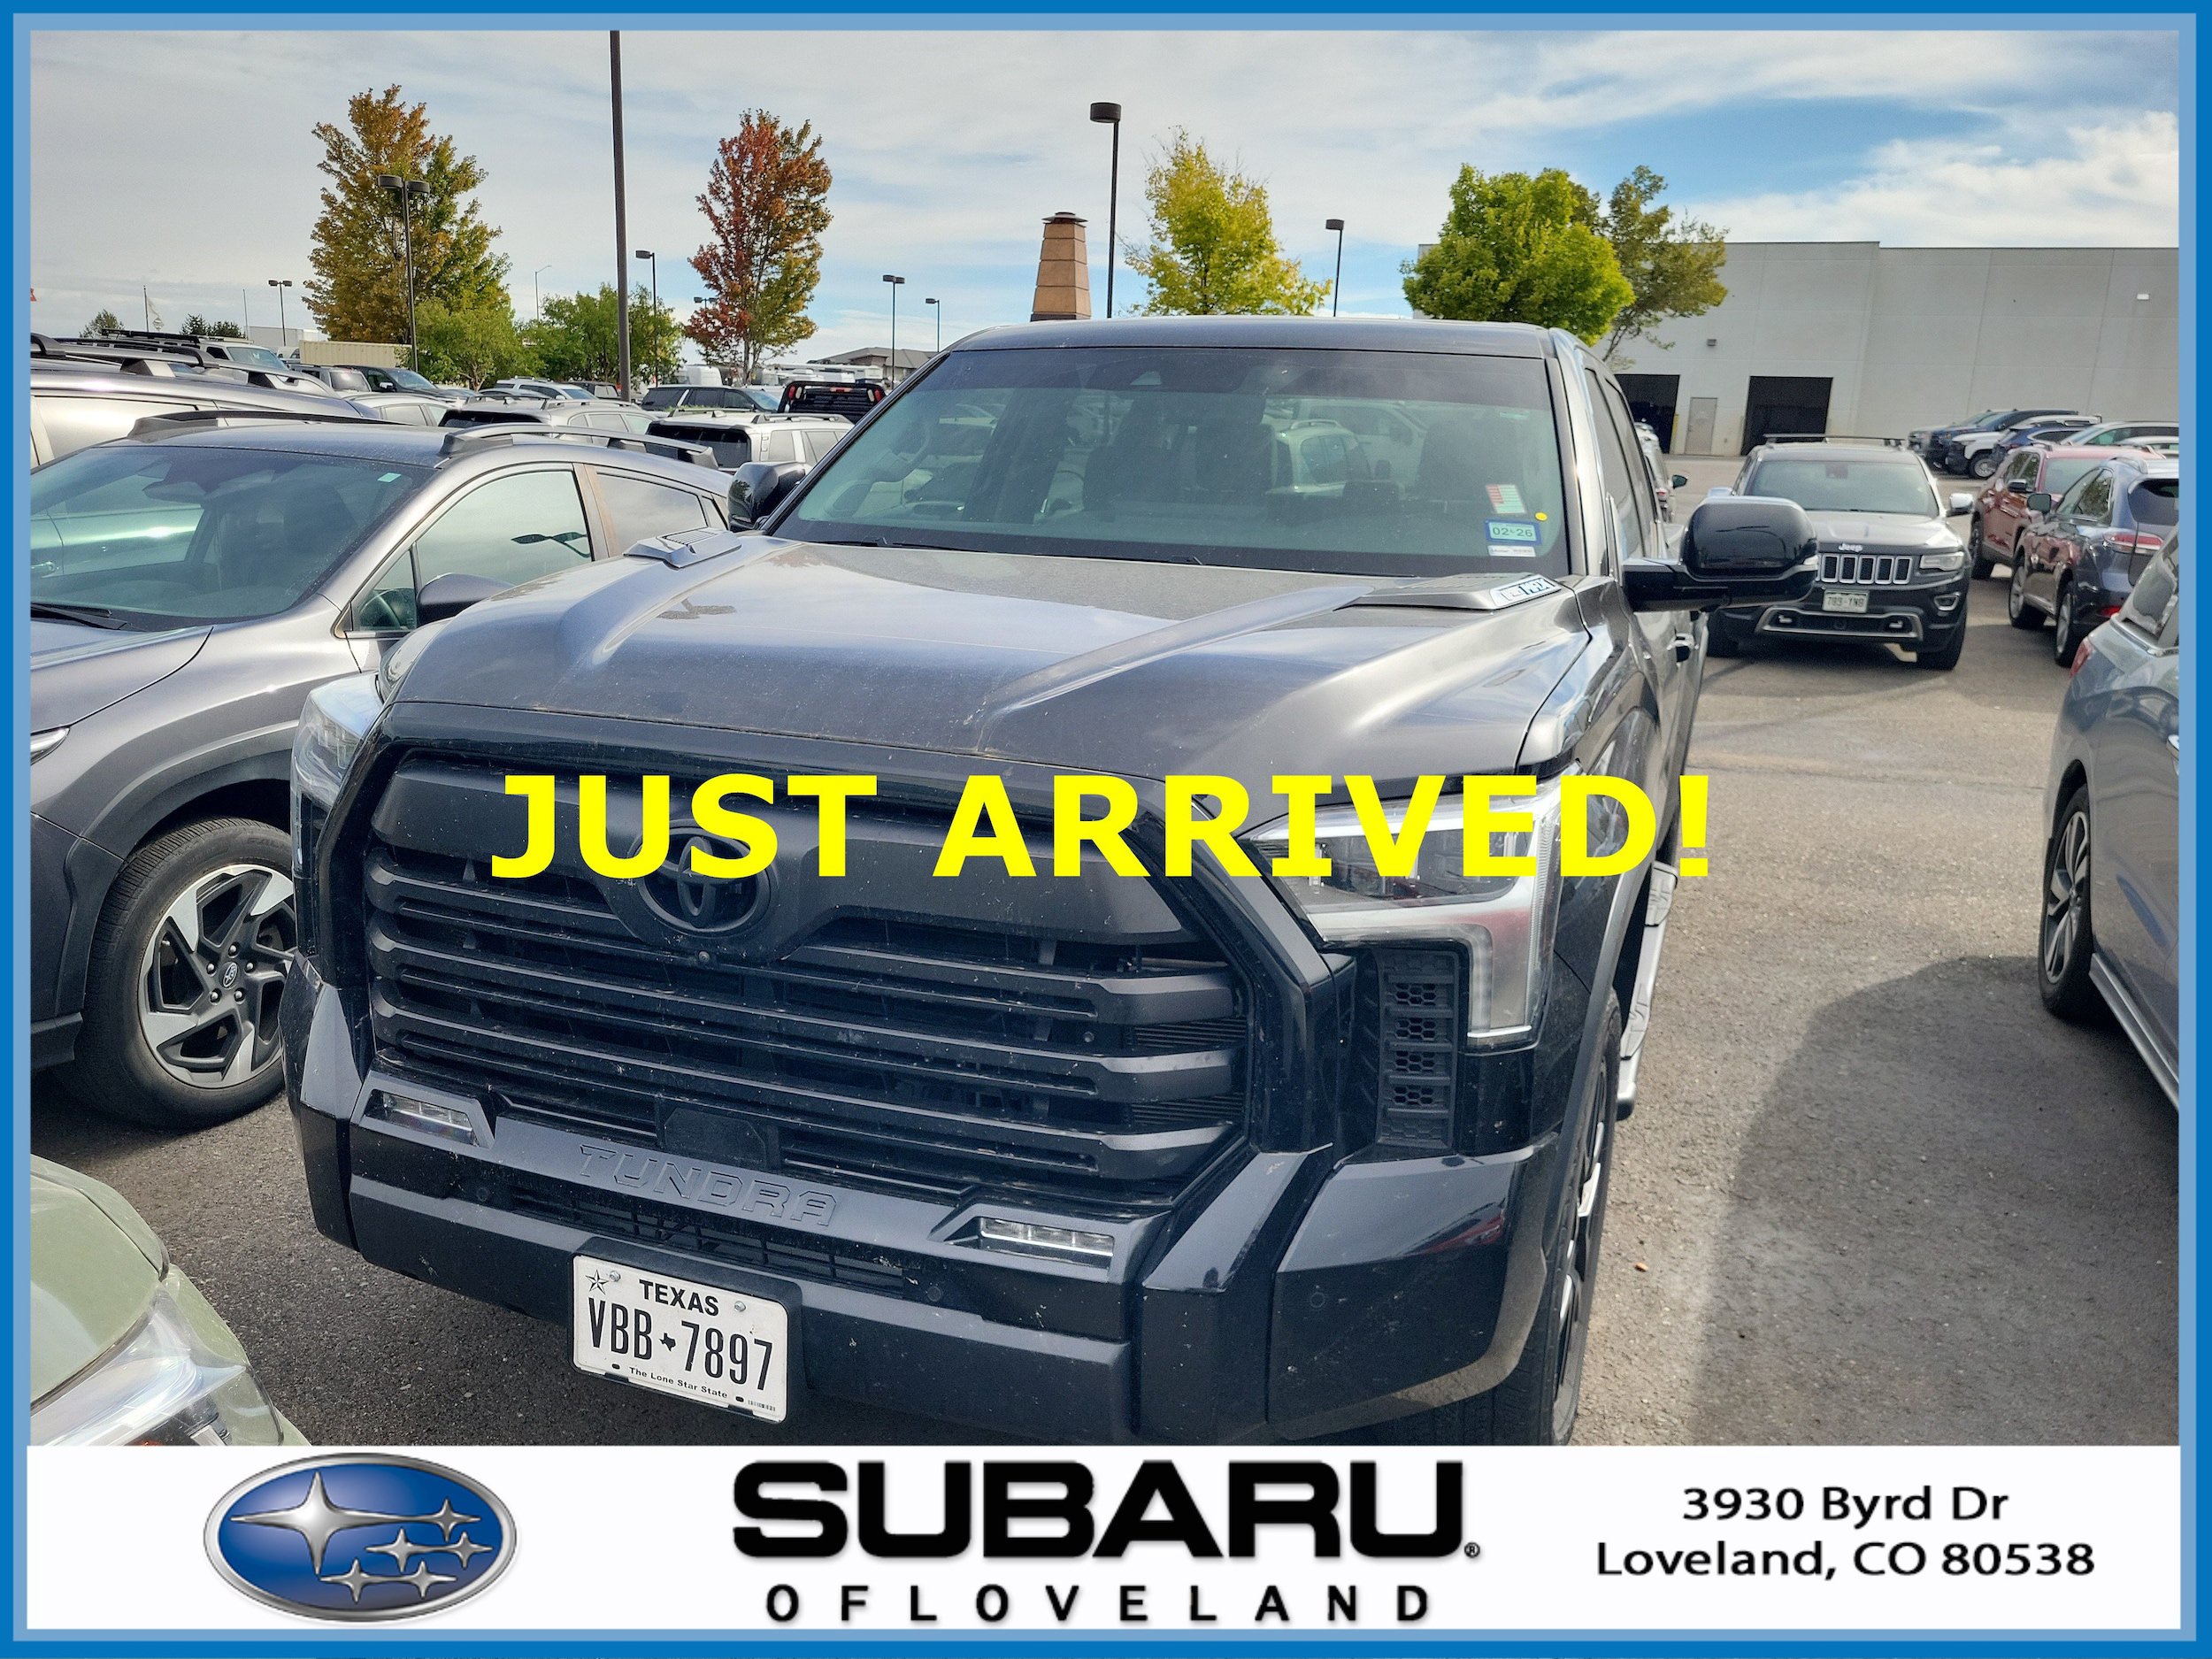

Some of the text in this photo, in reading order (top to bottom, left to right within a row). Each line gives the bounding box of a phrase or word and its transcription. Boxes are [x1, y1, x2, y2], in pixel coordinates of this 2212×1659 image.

[1838, 542, 1863, 553] Jeep
[580, 1144, 838, 1227] TUNDRA
[639, 1279, 719, 1317] TEXAS
[629, 1366, 728, 1398] The Lone Star State
